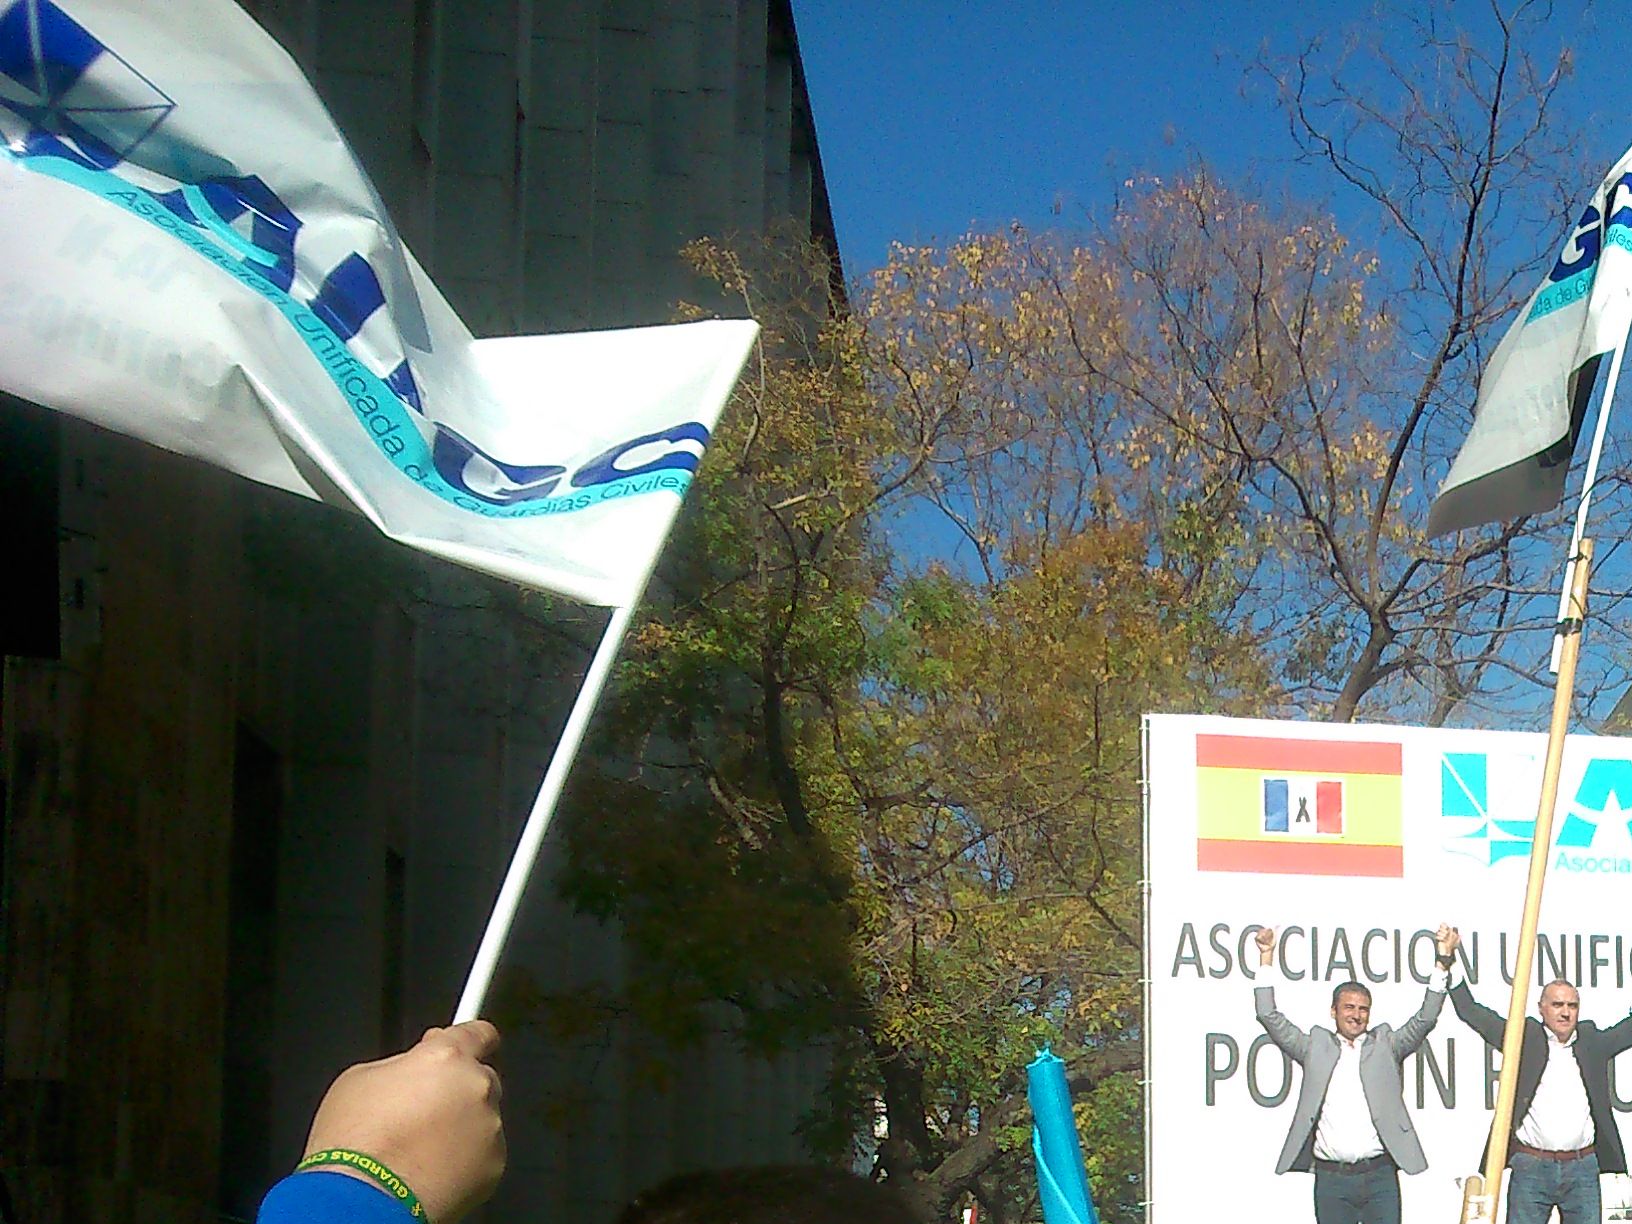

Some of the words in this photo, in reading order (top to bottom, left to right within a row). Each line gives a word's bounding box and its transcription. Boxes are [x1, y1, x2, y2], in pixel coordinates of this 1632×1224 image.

[295, 311, 405, 460] Unificada
[404, 463, 444, 494] de
[452, 494, 592, 518] Guardias
[331, 1151, 409, 1198] GUARDIAS
